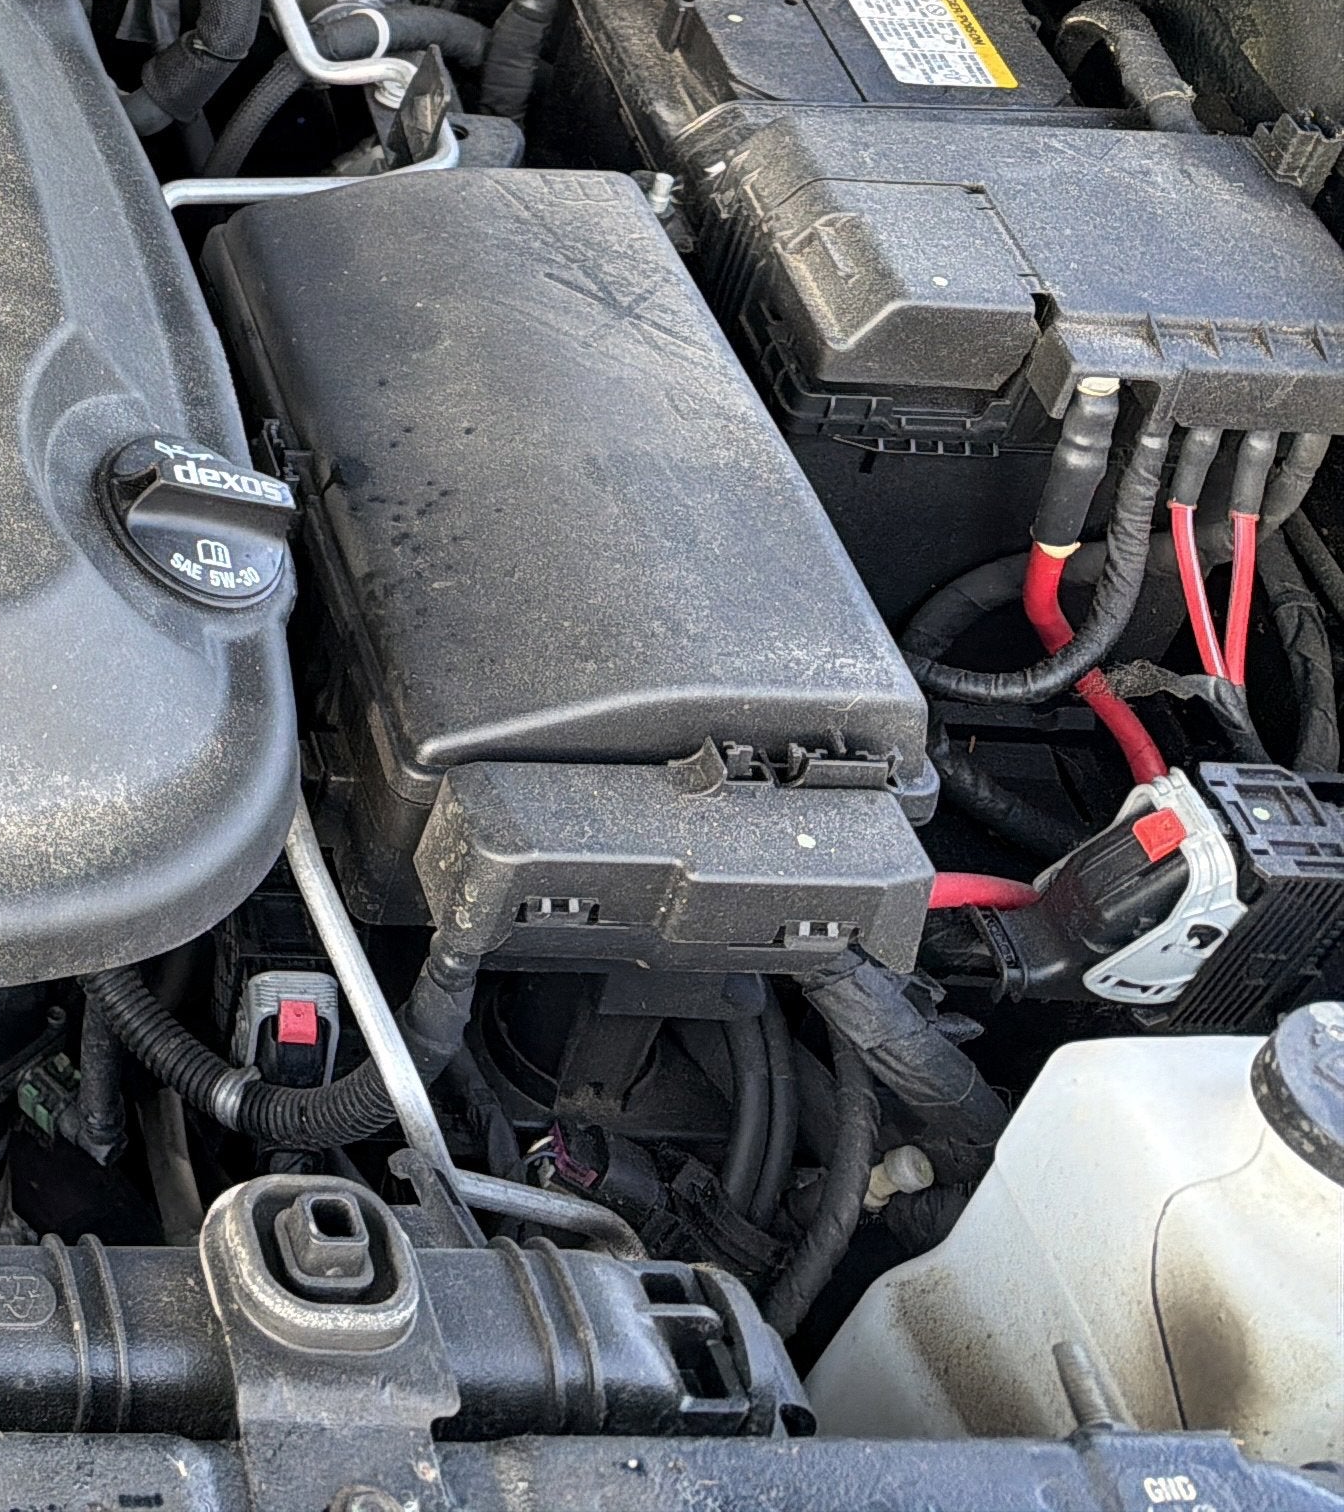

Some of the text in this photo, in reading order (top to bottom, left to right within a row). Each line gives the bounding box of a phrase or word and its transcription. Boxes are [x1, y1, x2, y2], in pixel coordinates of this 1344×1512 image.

[956, 14, 987, 46] POISON
[173, 460, 283, 502] dexos
[170, 552, 261, 589] SAE 5W-30
